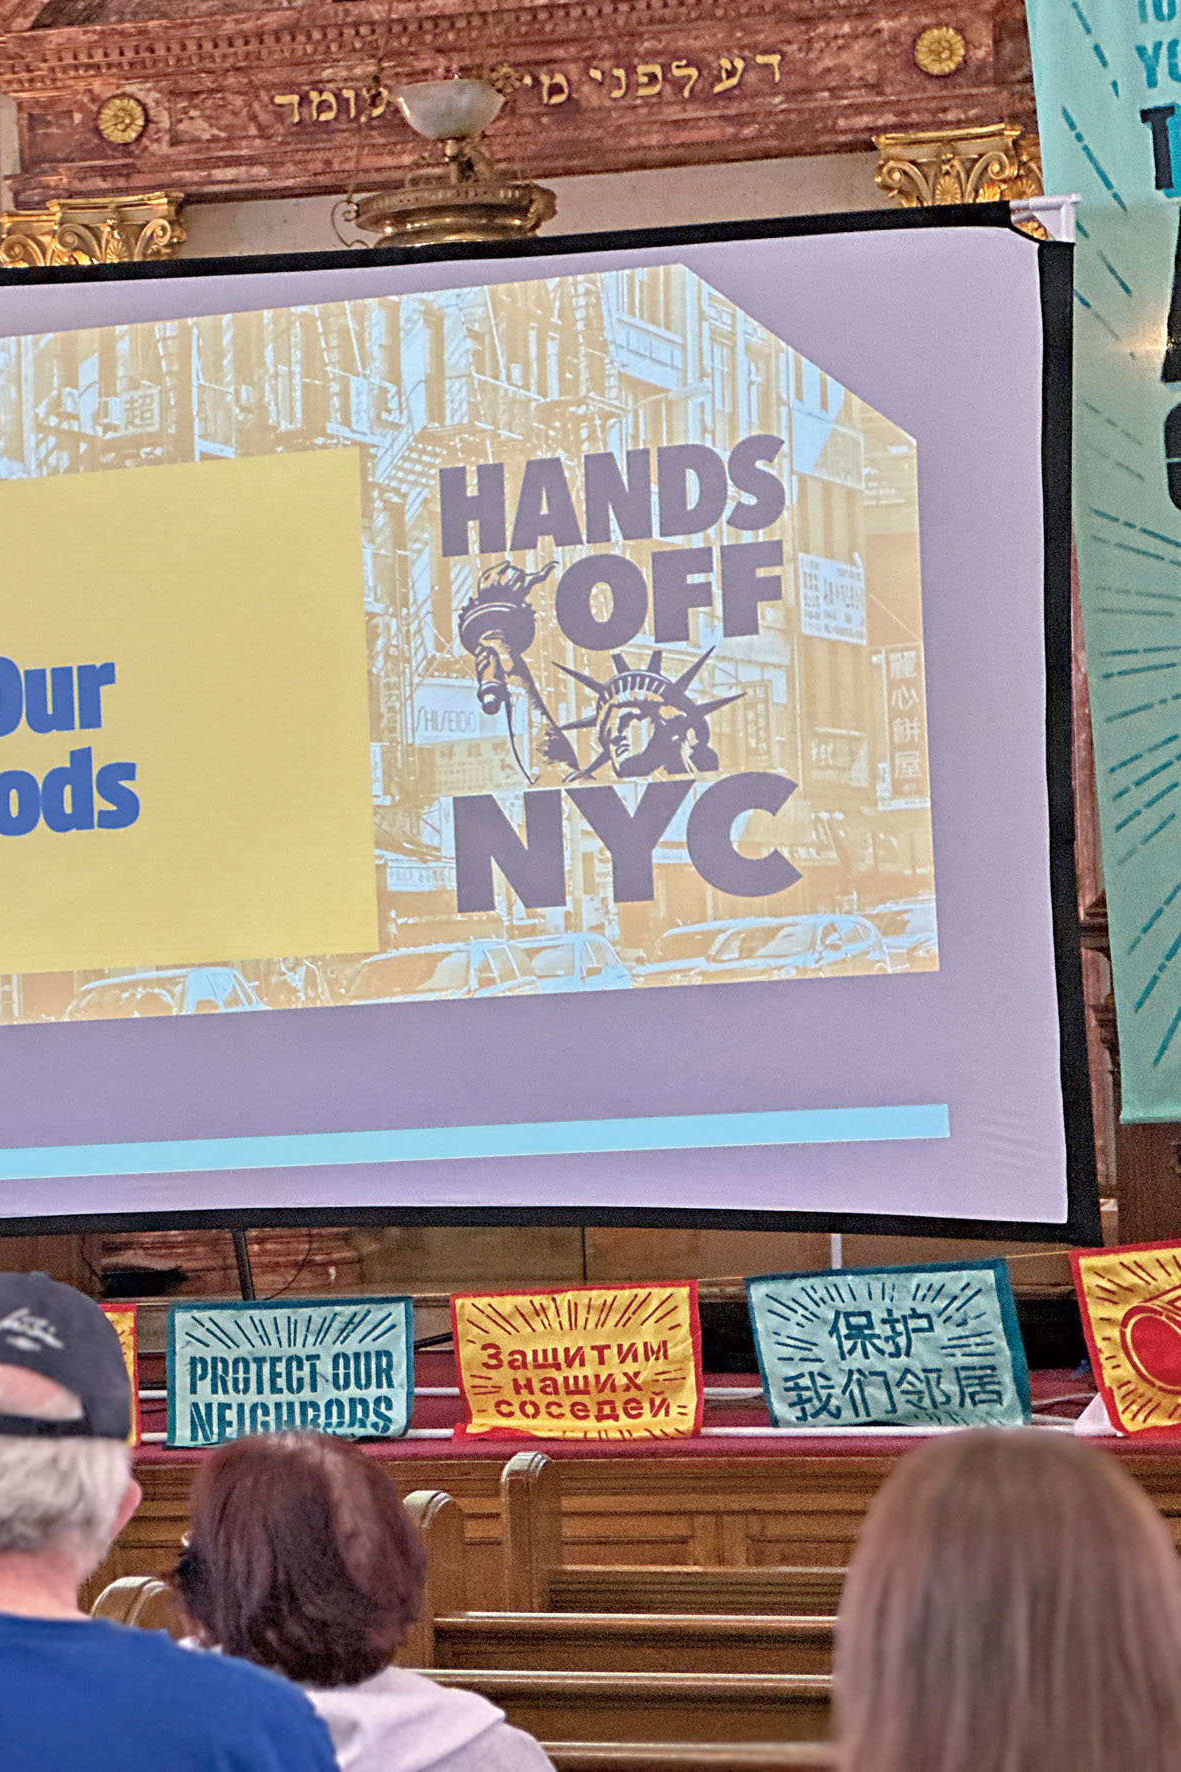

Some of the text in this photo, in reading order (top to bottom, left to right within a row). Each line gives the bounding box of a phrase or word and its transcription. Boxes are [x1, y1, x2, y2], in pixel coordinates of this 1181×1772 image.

[588, 58, 700, 99] לפני
[713, 53, 782, 95] דע
[438, 433, 786, 557] HANDS
[555, 539, 784, 652] OFF
[452, 771, 803, 914] NYC
[480, 1338, 671, 1374] Защитим
[828, 1307, 938, 1361] 保护
[189, 1350, 396, 1396] PROTECT OUR
[513, 1369, 643, 1399] наших
[782, 1363, 1005, 1424] 我们邻居
[494, 1393, 671, 1425] соседей
